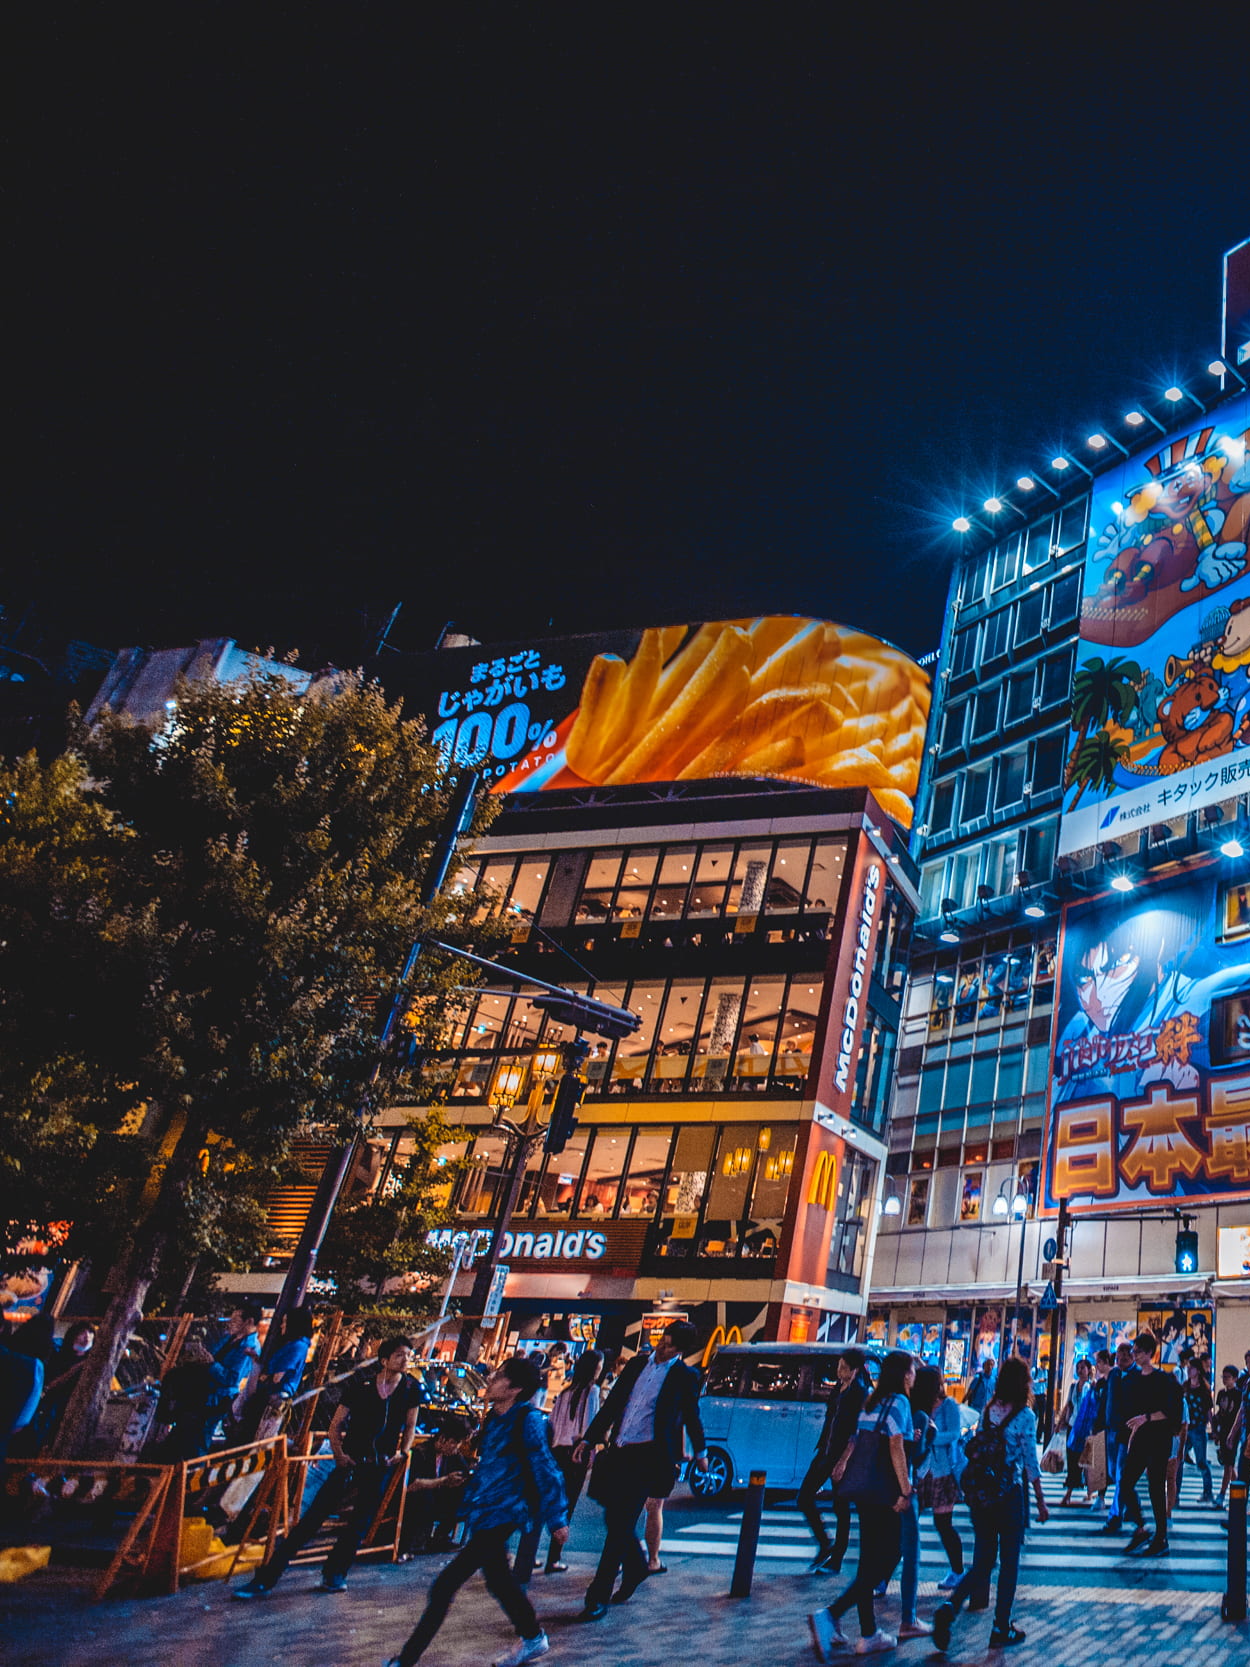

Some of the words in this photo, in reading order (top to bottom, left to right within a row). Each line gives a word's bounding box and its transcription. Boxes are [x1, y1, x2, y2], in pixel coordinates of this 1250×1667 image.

[470, 649, 541, 684] まるごと
[438, 663, 567, 718] じゃがいも
[482, 753, 556, 780] POTATO
[1119, 802, 1151, 822] 株式会社
[833, 864, 881, 1094] McDonald's
